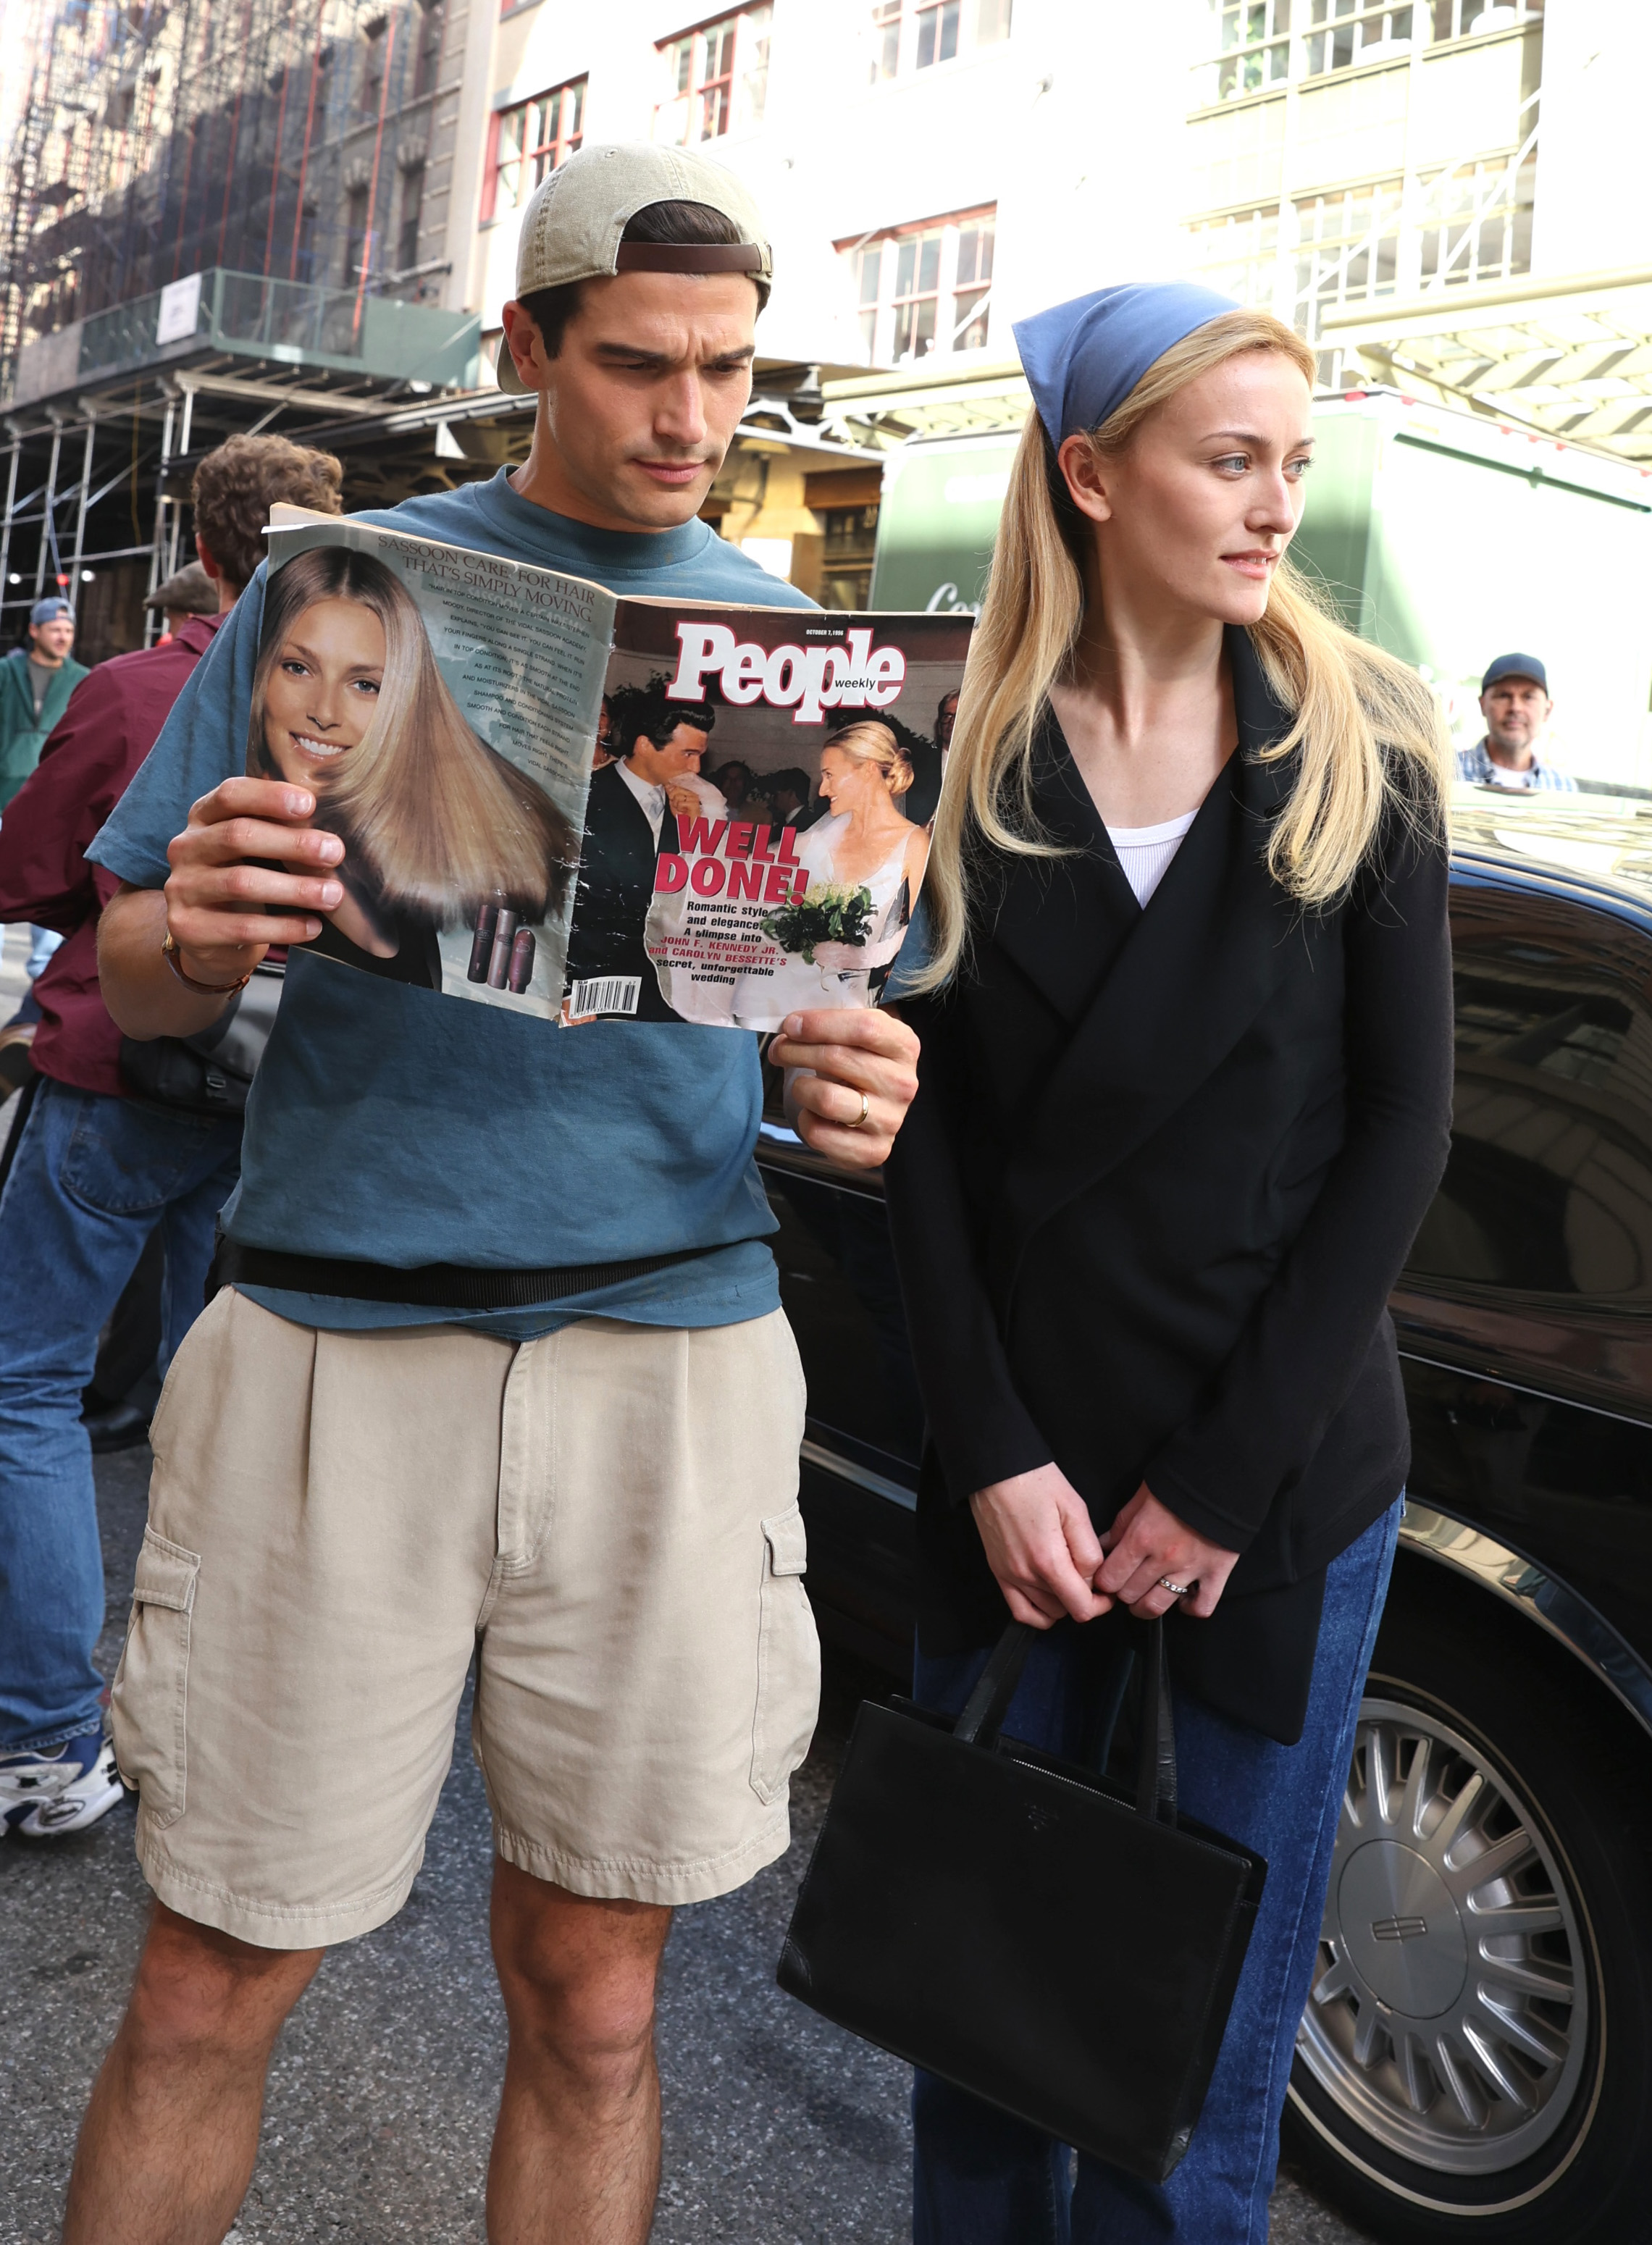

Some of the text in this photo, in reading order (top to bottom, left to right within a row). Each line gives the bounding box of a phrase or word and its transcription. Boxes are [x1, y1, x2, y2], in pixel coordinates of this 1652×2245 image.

[378, 536, 595, 605] SASSOON CARE FOR HAIR
[403, 556, 592, 623] THAT'S SIMPLY MOVING
[466, 594, 497, 607] CONDITION
[526, 610, 549, 622] CERTAIN
[566, 624, 590, 638] STEPHEN
[466, 607, 495, 618] DIRECTOR
[517, 621, 533, 631] VIDAL
[534, 627, 561, 640] SASSOON
[443, 626, 461, 636] YOUR
[462, 630, 487, 642] FINGERS
[488, 638, 507, 649] ALONG
[513, 646, 533, 658] SINGLE
[557, 663, 572, 674] WHEN
[450, 614, 479, 628] EXPLAINS,
[542, 643, 553, 652] CAN
[554, 647, 566, 658] FEEL
[574, 656, 585, 666] RUN
[523, 676, 533, 685] THE
[534, 681, 555, 695] NATURAL
[529, 665, 551, 678] SMOOTH
[559, 678, 569, 687] THE
[569, 683, 581, 692] END
[665, 621, 907, 726] People
[834, 678, 876, 690] weekly
[474, 689, 504, 701] SHAMPOO
[518, 701, 553, 721] CONDITIONING
[478, 676, 519, 692] MOISTURIZERS
[527, 691, 536, 700] THE
[537, 696, 550, 707] VIDAL
[552, 704, 575, 718] SASSOON
[466, 702, 492, 711] SMOOTH
[507, 712, 536, 726] CONDITION
[537, 723, 550, 732] EACH
[512, 726, 525, 734] HAIR
[526, 731, 539, 740] THAT
[540, 737, 555, 747] FEELS
[512, 740, 532, 750] MOVES
[527, 759, 542, 769] VIDAL
[676, 814, 800, 867] WELL
[653, 852, 810, 905] DONE!
[687, 901, 768, 918] Romantic style
[687, 917, 707, 926] and
[661, 936, 779, 955] JOHN F. KENNEDY JR.
[695, 929, 737, 941] glimpse
[741, 933, 762, 943] into
[649, 946, 787, 966] and CAROLYN BESSETTE'S
[656, 959, 774, 977] secret, unforgettable
[691, 973, 736, 985] wedding
